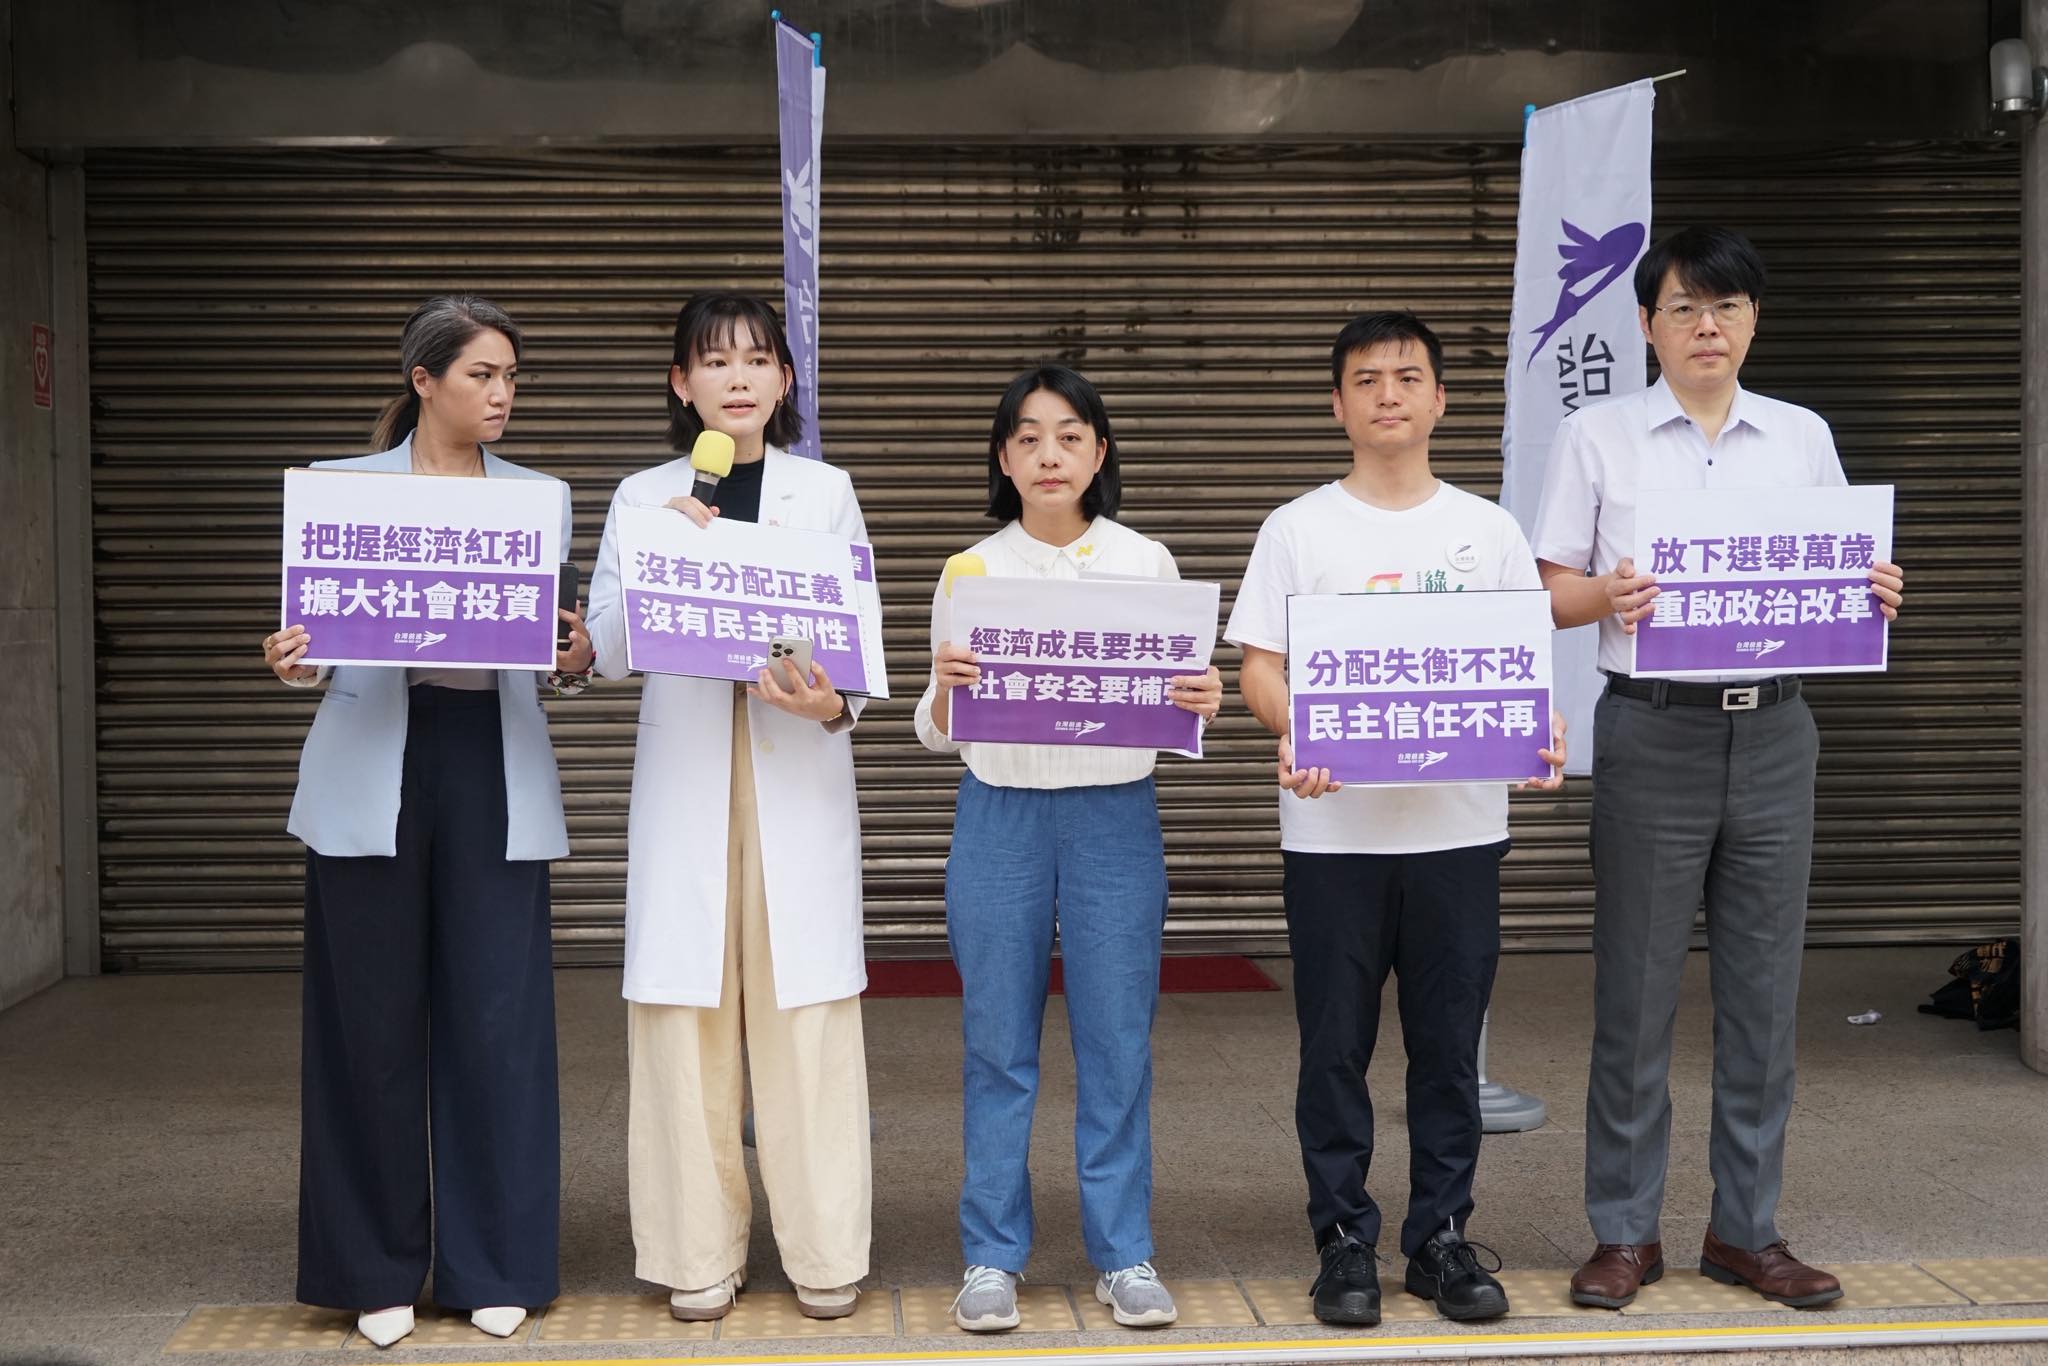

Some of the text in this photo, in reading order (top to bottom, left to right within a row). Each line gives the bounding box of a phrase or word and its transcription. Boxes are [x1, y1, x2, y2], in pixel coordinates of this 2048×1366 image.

[1582, 333, 1615, 396] 台
[301, 521, 542, 568] 把握經濟紅利
[1650, 532, 1876, 574] 放下選舉萬歲
[300, 577, 540, 622] 擴大社會投資
[635, 551, 844, 606] 沒有分配正義
[638, 597, 851, 652] 沒有民主韌性
[1650, 585, 1873, 628] 重啟政治改革
[969, 626, 1197, 662] 經濟成長要共享
[1306, 645, 1536, 687] 分配失衡不改
[968, 670, 1178, 706] 社會安全要補
[1308, 700, 1538, 742] 民主信任不再
